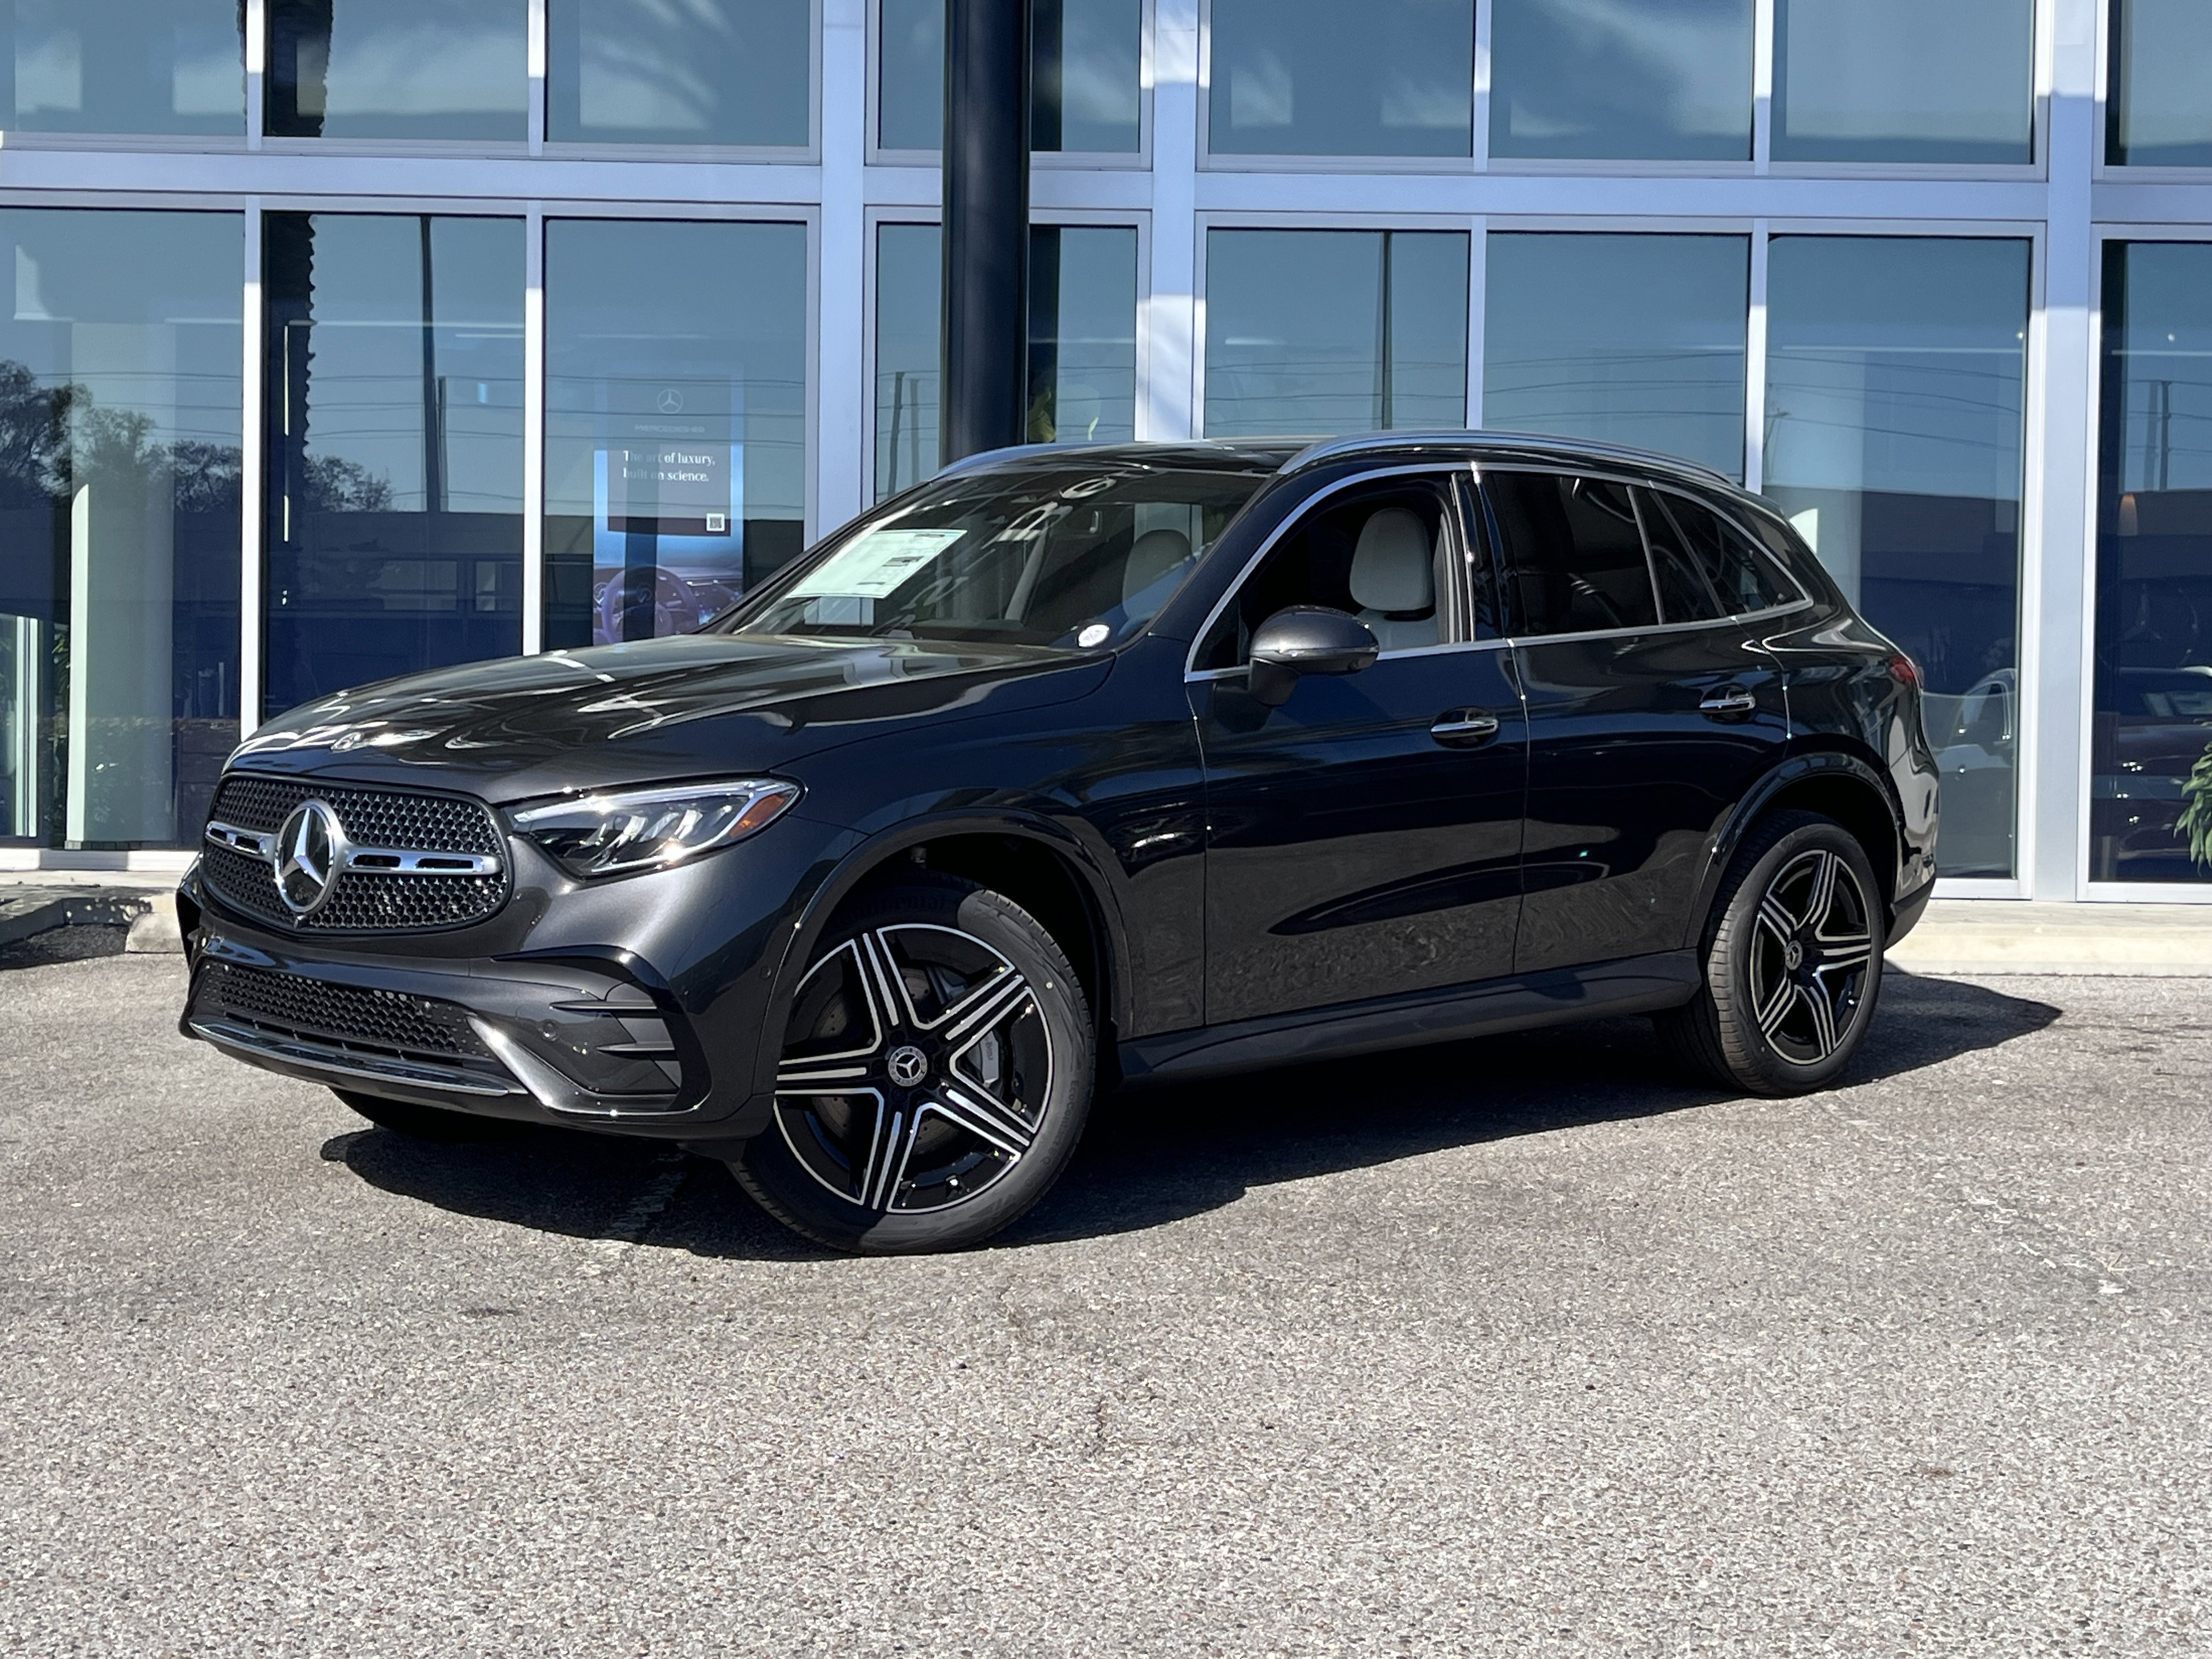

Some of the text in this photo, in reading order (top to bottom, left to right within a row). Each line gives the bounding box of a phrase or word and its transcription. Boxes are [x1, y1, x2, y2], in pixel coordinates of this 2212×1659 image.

[623, 450, 644, 462] The
[664, 453, 676, 464] of
[678, 453, 715, 466] luxury,
[623, 467, 709, 482] built on science.
